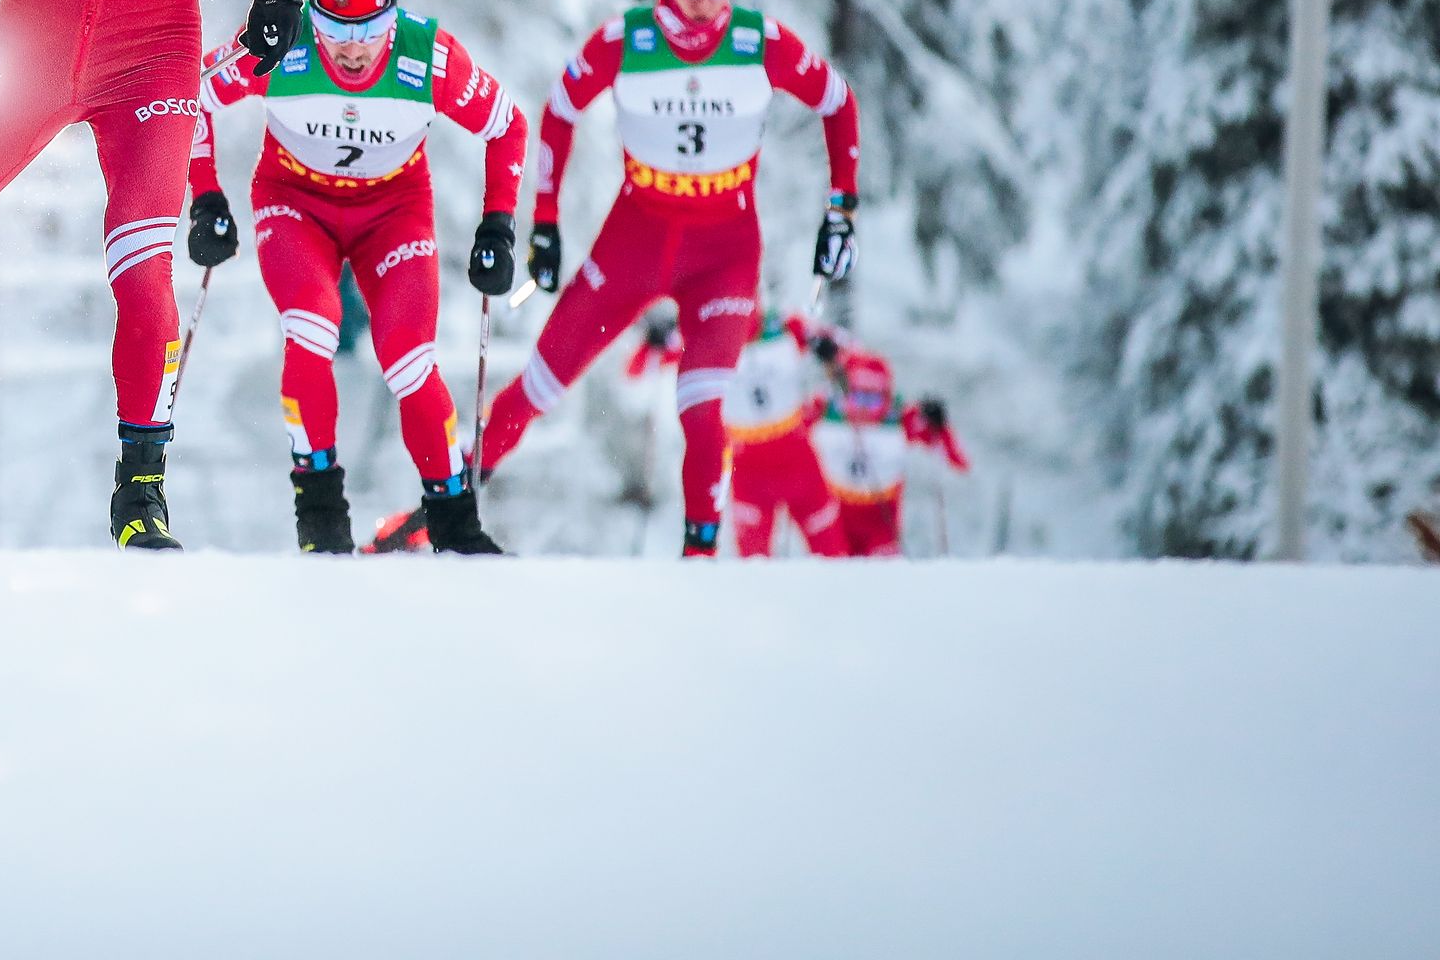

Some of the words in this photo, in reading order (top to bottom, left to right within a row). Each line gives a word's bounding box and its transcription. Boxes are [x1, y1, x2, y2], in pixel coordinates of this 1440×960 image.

[134, 98, 199, 123] BOSCO
[652, 98, 735, 114] VELTINS
[306, 122, 396, 144] VELTINS
[678, 123, 705, 154] 3
[334, 145, 364, 168] 2
